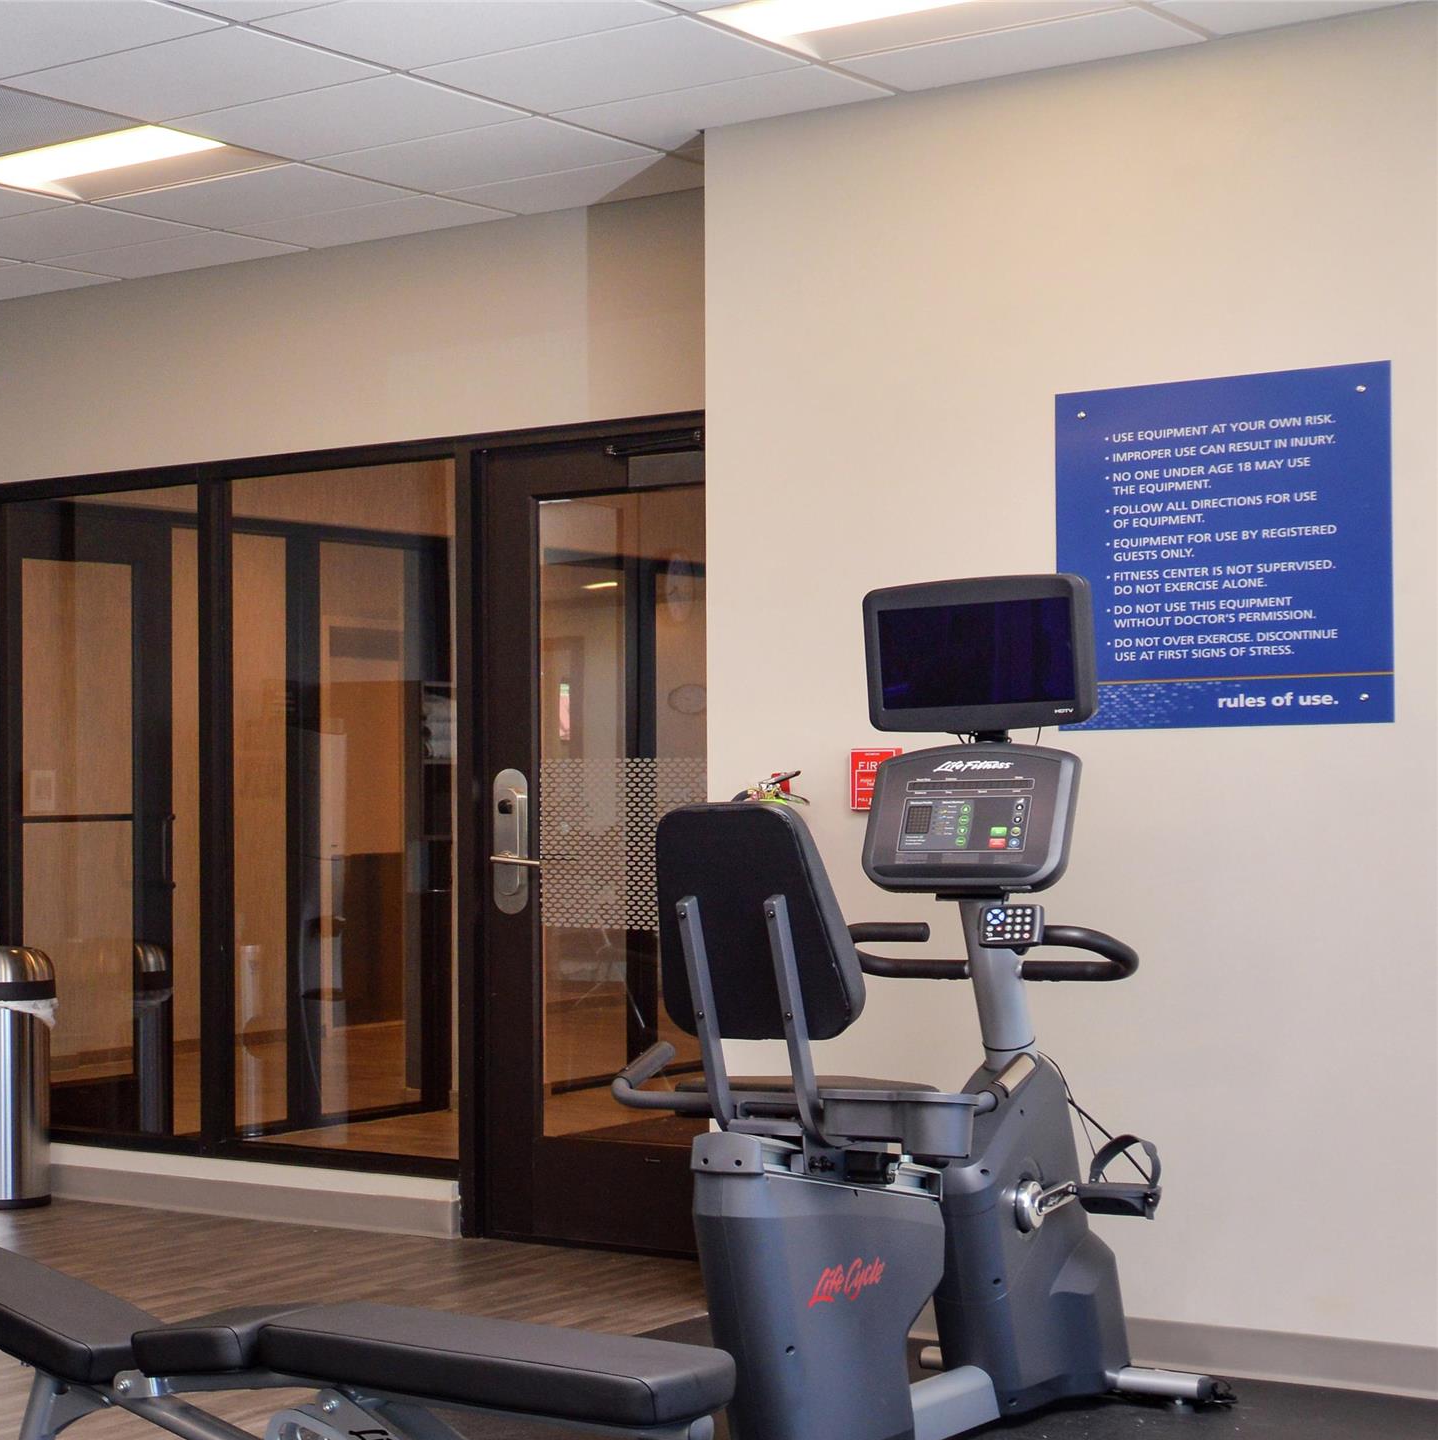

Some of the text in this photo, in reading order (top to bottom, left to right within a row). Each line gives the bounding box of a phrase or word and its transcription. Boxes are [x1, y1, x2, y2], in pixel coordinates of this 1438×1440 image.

[1113, 414, 1336, 443] USE EQUIPMENT AT YOUR OWN RISK.
[1113, 434, 1335, 462] IMPROPER USE CAN RESULT IN INJURY.
[1113, 457, 1311, 482] NO ONE UNDER AGE 18 MAY USE
[1113, 479, 1211, 495] THE EQUIPMENT.
[1113, 491, 1317, 515] FOLLOW ALL DIRECTIONS FOR USE
[1114, 513, 1205, 528] OF EQUIPMENT.
[1114, 524, 1337, 548] EQUIPMENT FOR USE BY REGISTERED
[1114, 548, 1194, 562] GUESTS ONLY.
[1114, 560, 1336, 581] FITNESS CENTER IS NOT SUPERVISED.
[1115, 578, 1267, 595] DO NOT EXERCISE ALONE.
[1115, 597, 1292, 615] DO NOT USE THIS EQUIPMENT
[1115, 610, 1316, 629] WITHOUT DOCTOR'S PERMISSION.
[1115, 629, 1338, 648] DO NOT OVER EXERCISE. DISCONTINUE
[1115, 644, 1294, 661] USE AT FIRST SIGNS OF STRESS.
[1218, 692, 1338, 708] rules of use.
[858, 761, 881, 770] FIR
[960, 760, 1011, 772] Fitness
[808, 1256, 885, 1308] Life Cycle
